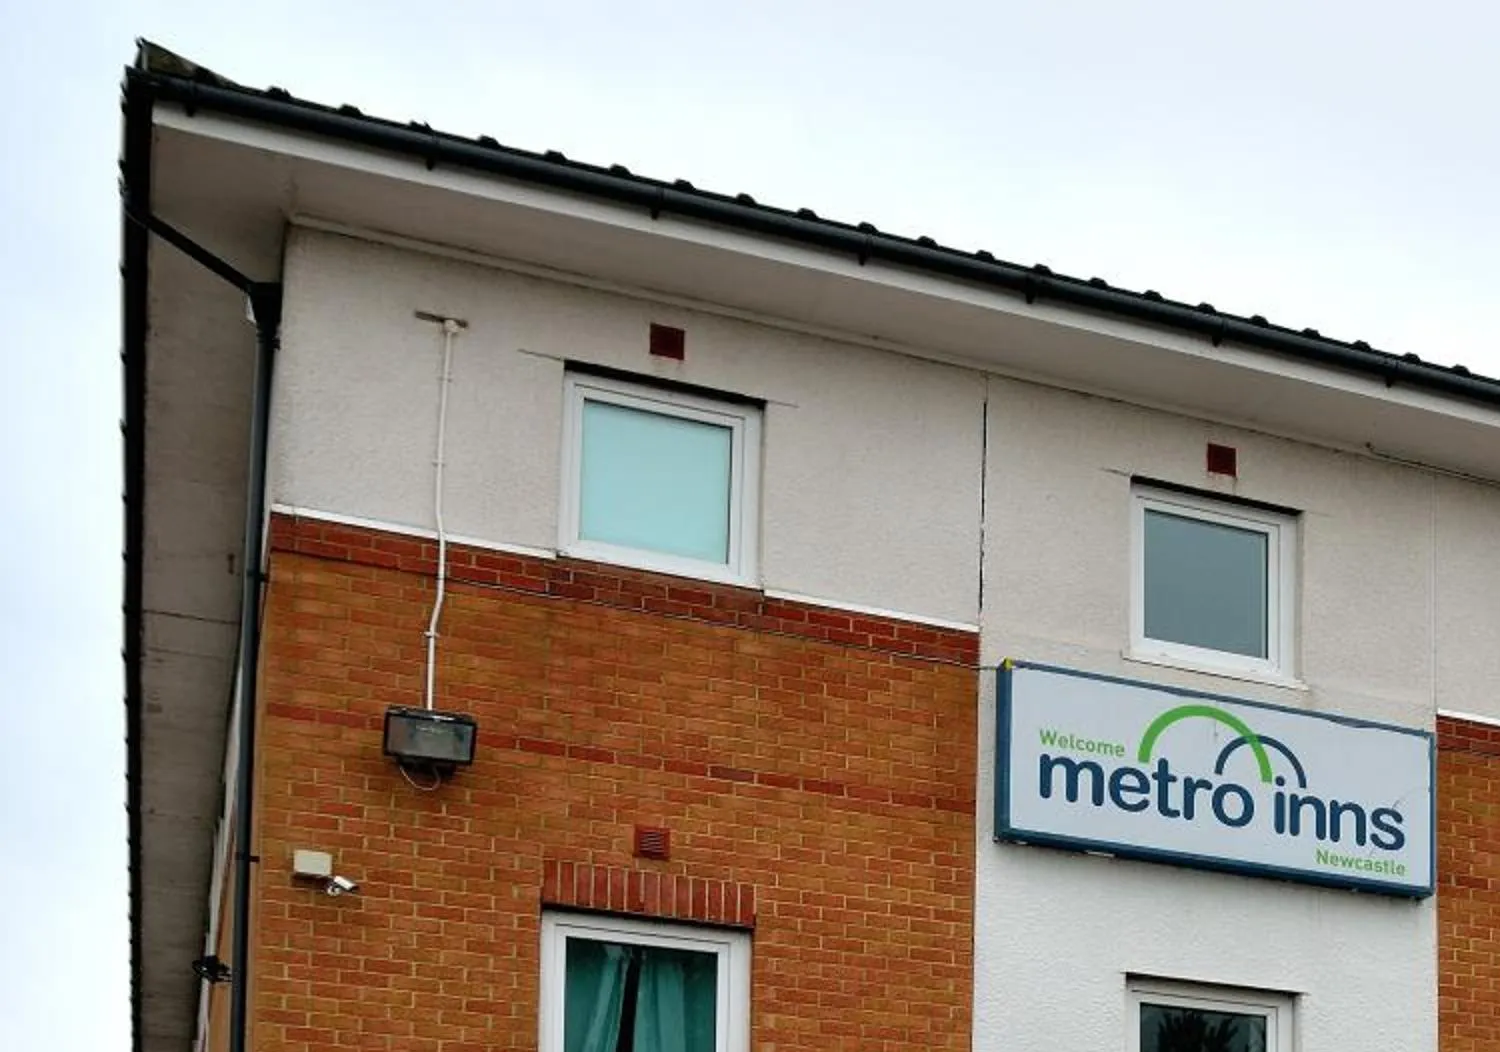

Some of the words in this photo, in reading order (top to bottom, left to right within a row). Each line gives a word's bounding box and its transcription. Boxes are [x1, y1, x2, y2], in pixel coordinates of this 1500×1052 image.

[1039, 728, 1125, 757] Welcome
[1039, 754, 1255, 827] metro
[1275, 776, 1406, 850] inns
[1316, 849, 1406, 876] Newcastle
